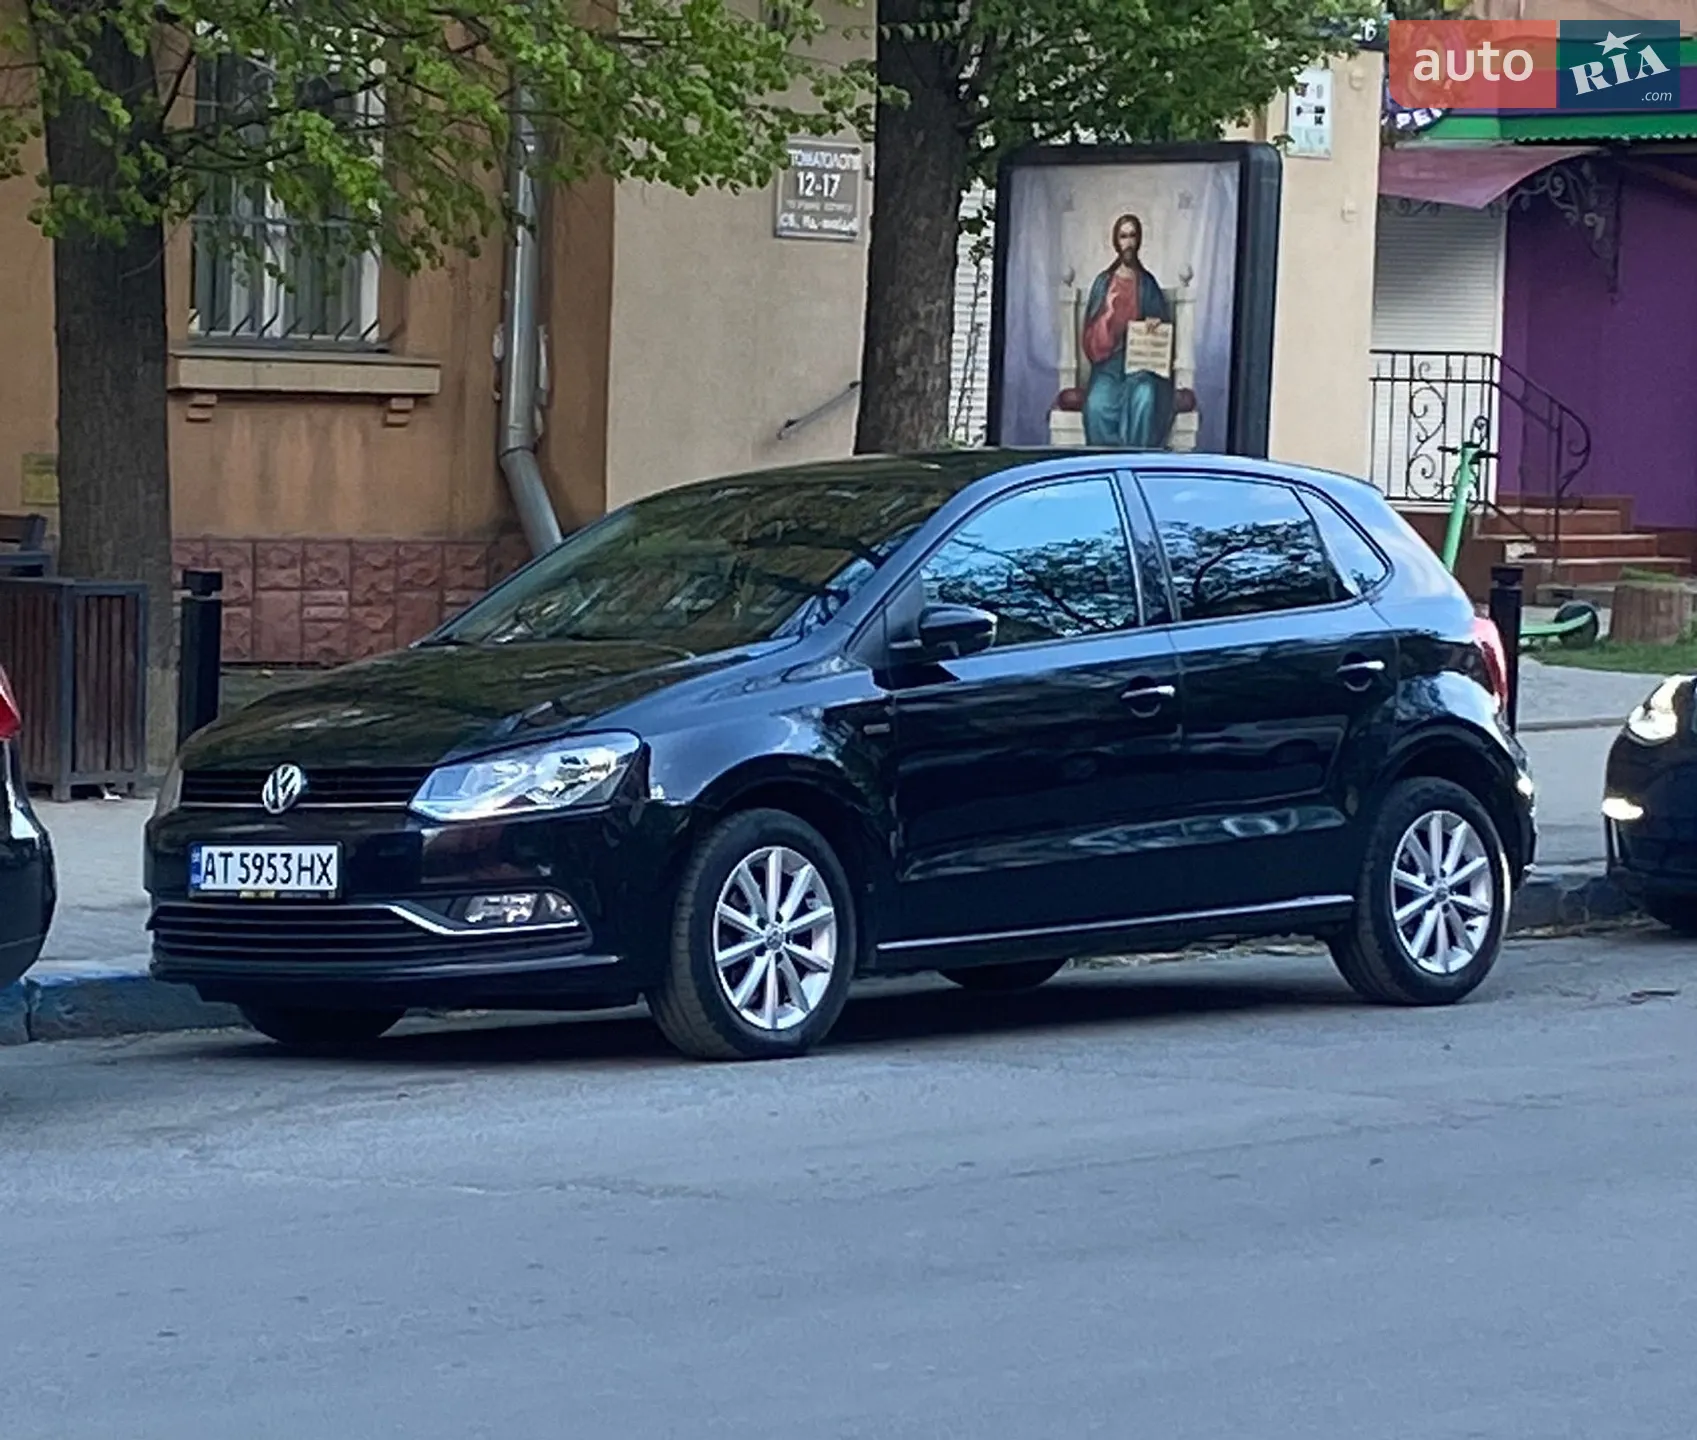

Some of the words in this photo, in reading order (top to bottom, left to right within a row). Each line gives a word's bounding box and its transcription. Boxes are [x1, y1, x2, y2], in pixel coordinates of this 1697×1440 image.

[797, 170, 841, 198] 12-17
[203, 852, 234, 885] AT
[237, 852, 292, 885] 5953
[297, 852, 334, 887] HX
